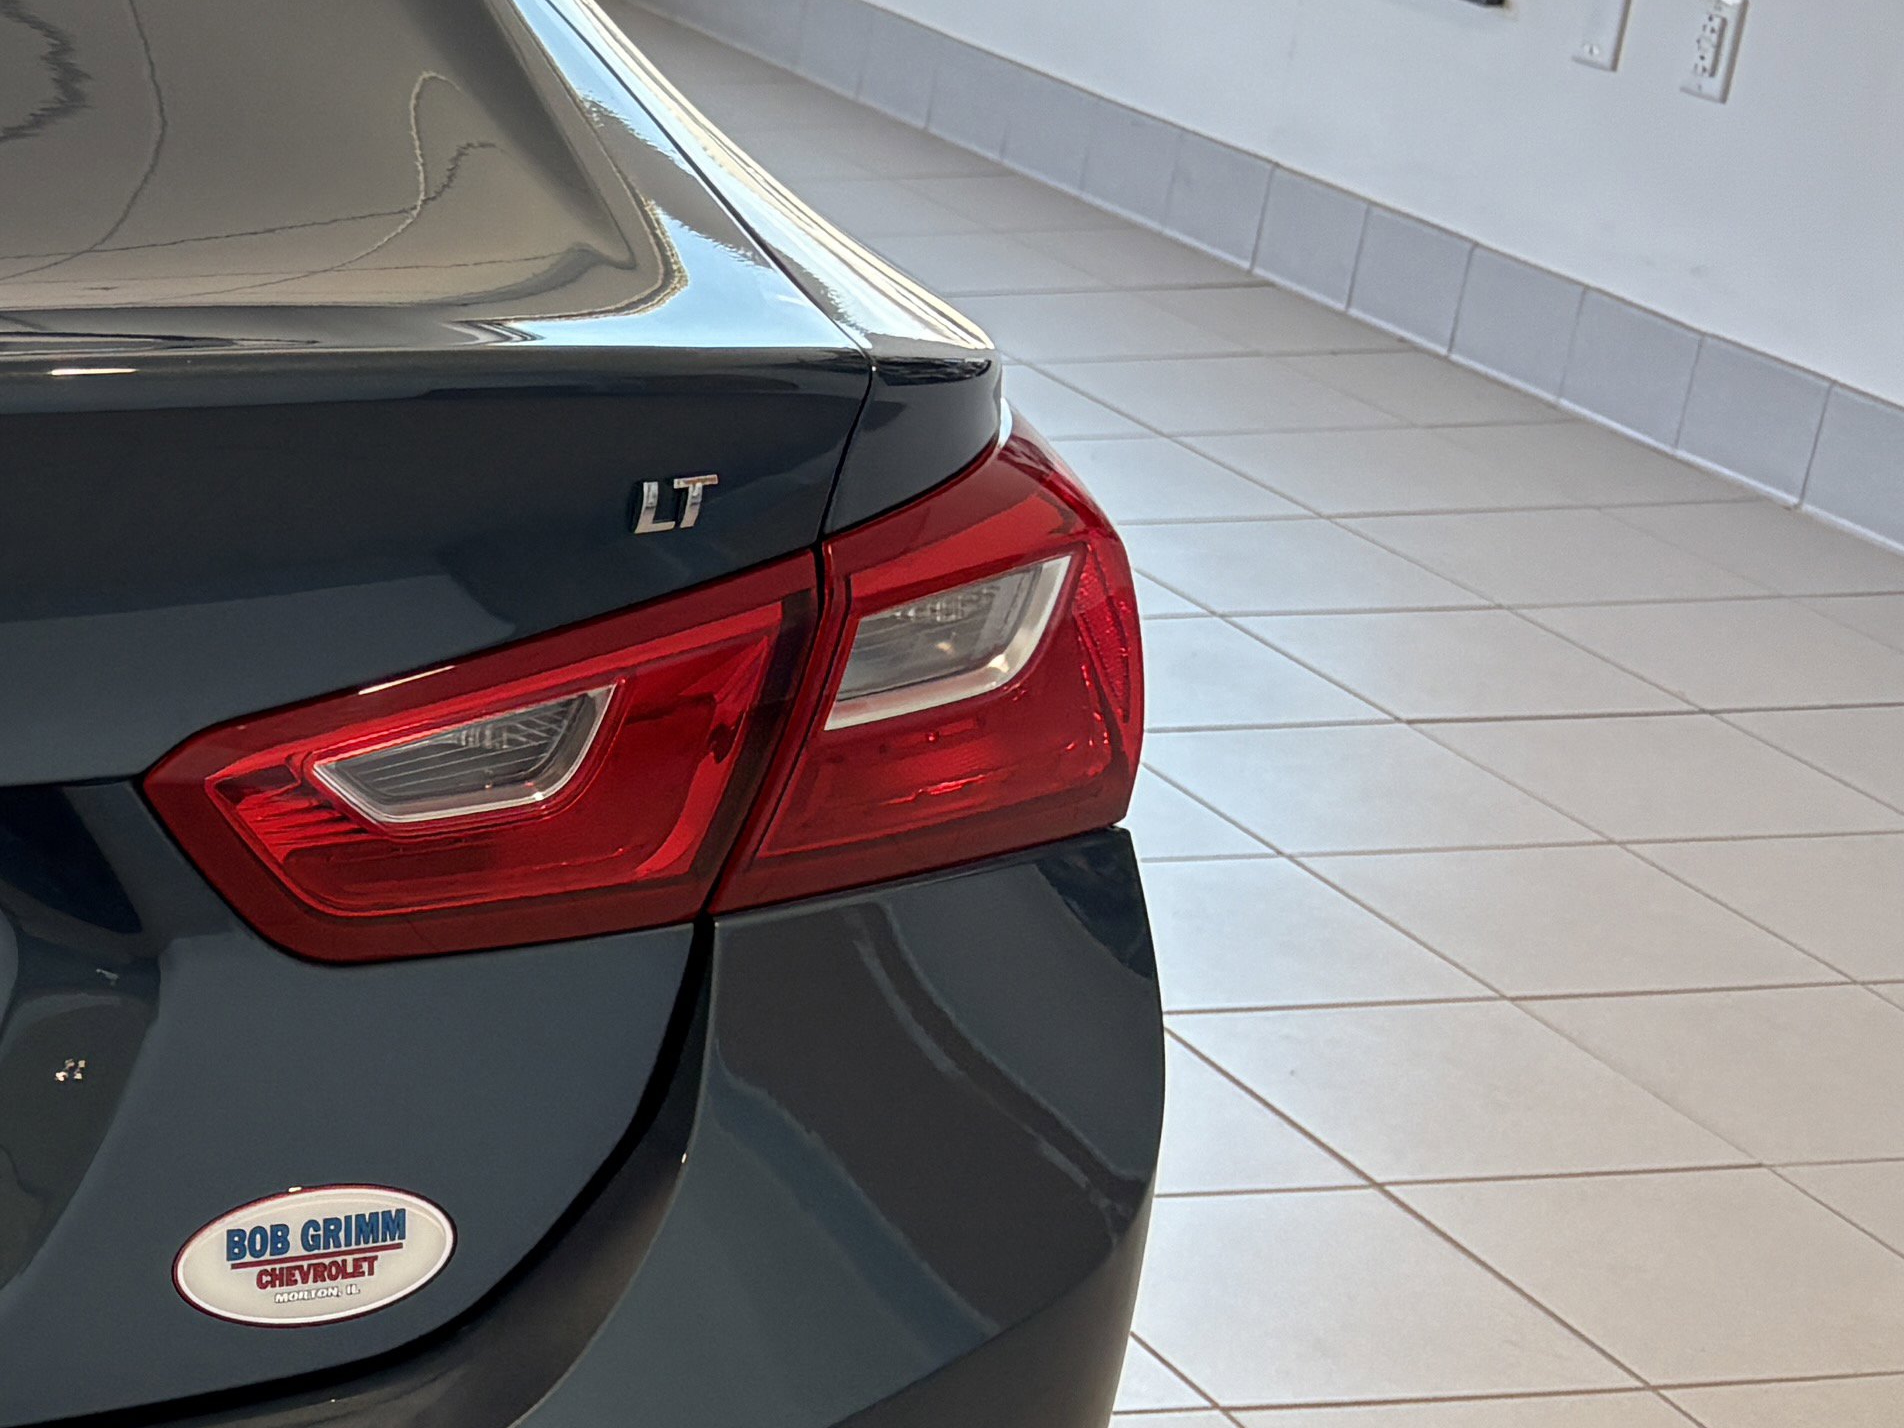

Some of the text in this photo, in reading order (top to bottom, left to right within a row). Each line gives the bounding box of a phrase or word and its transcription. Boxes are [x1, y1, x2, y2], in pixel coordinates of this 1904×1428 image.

[634, 474, 718, 534] LT
[226, 1208, 406, 1261] BOB GRIMM
[255, 1255, 379, 1290] CHEVROLET
